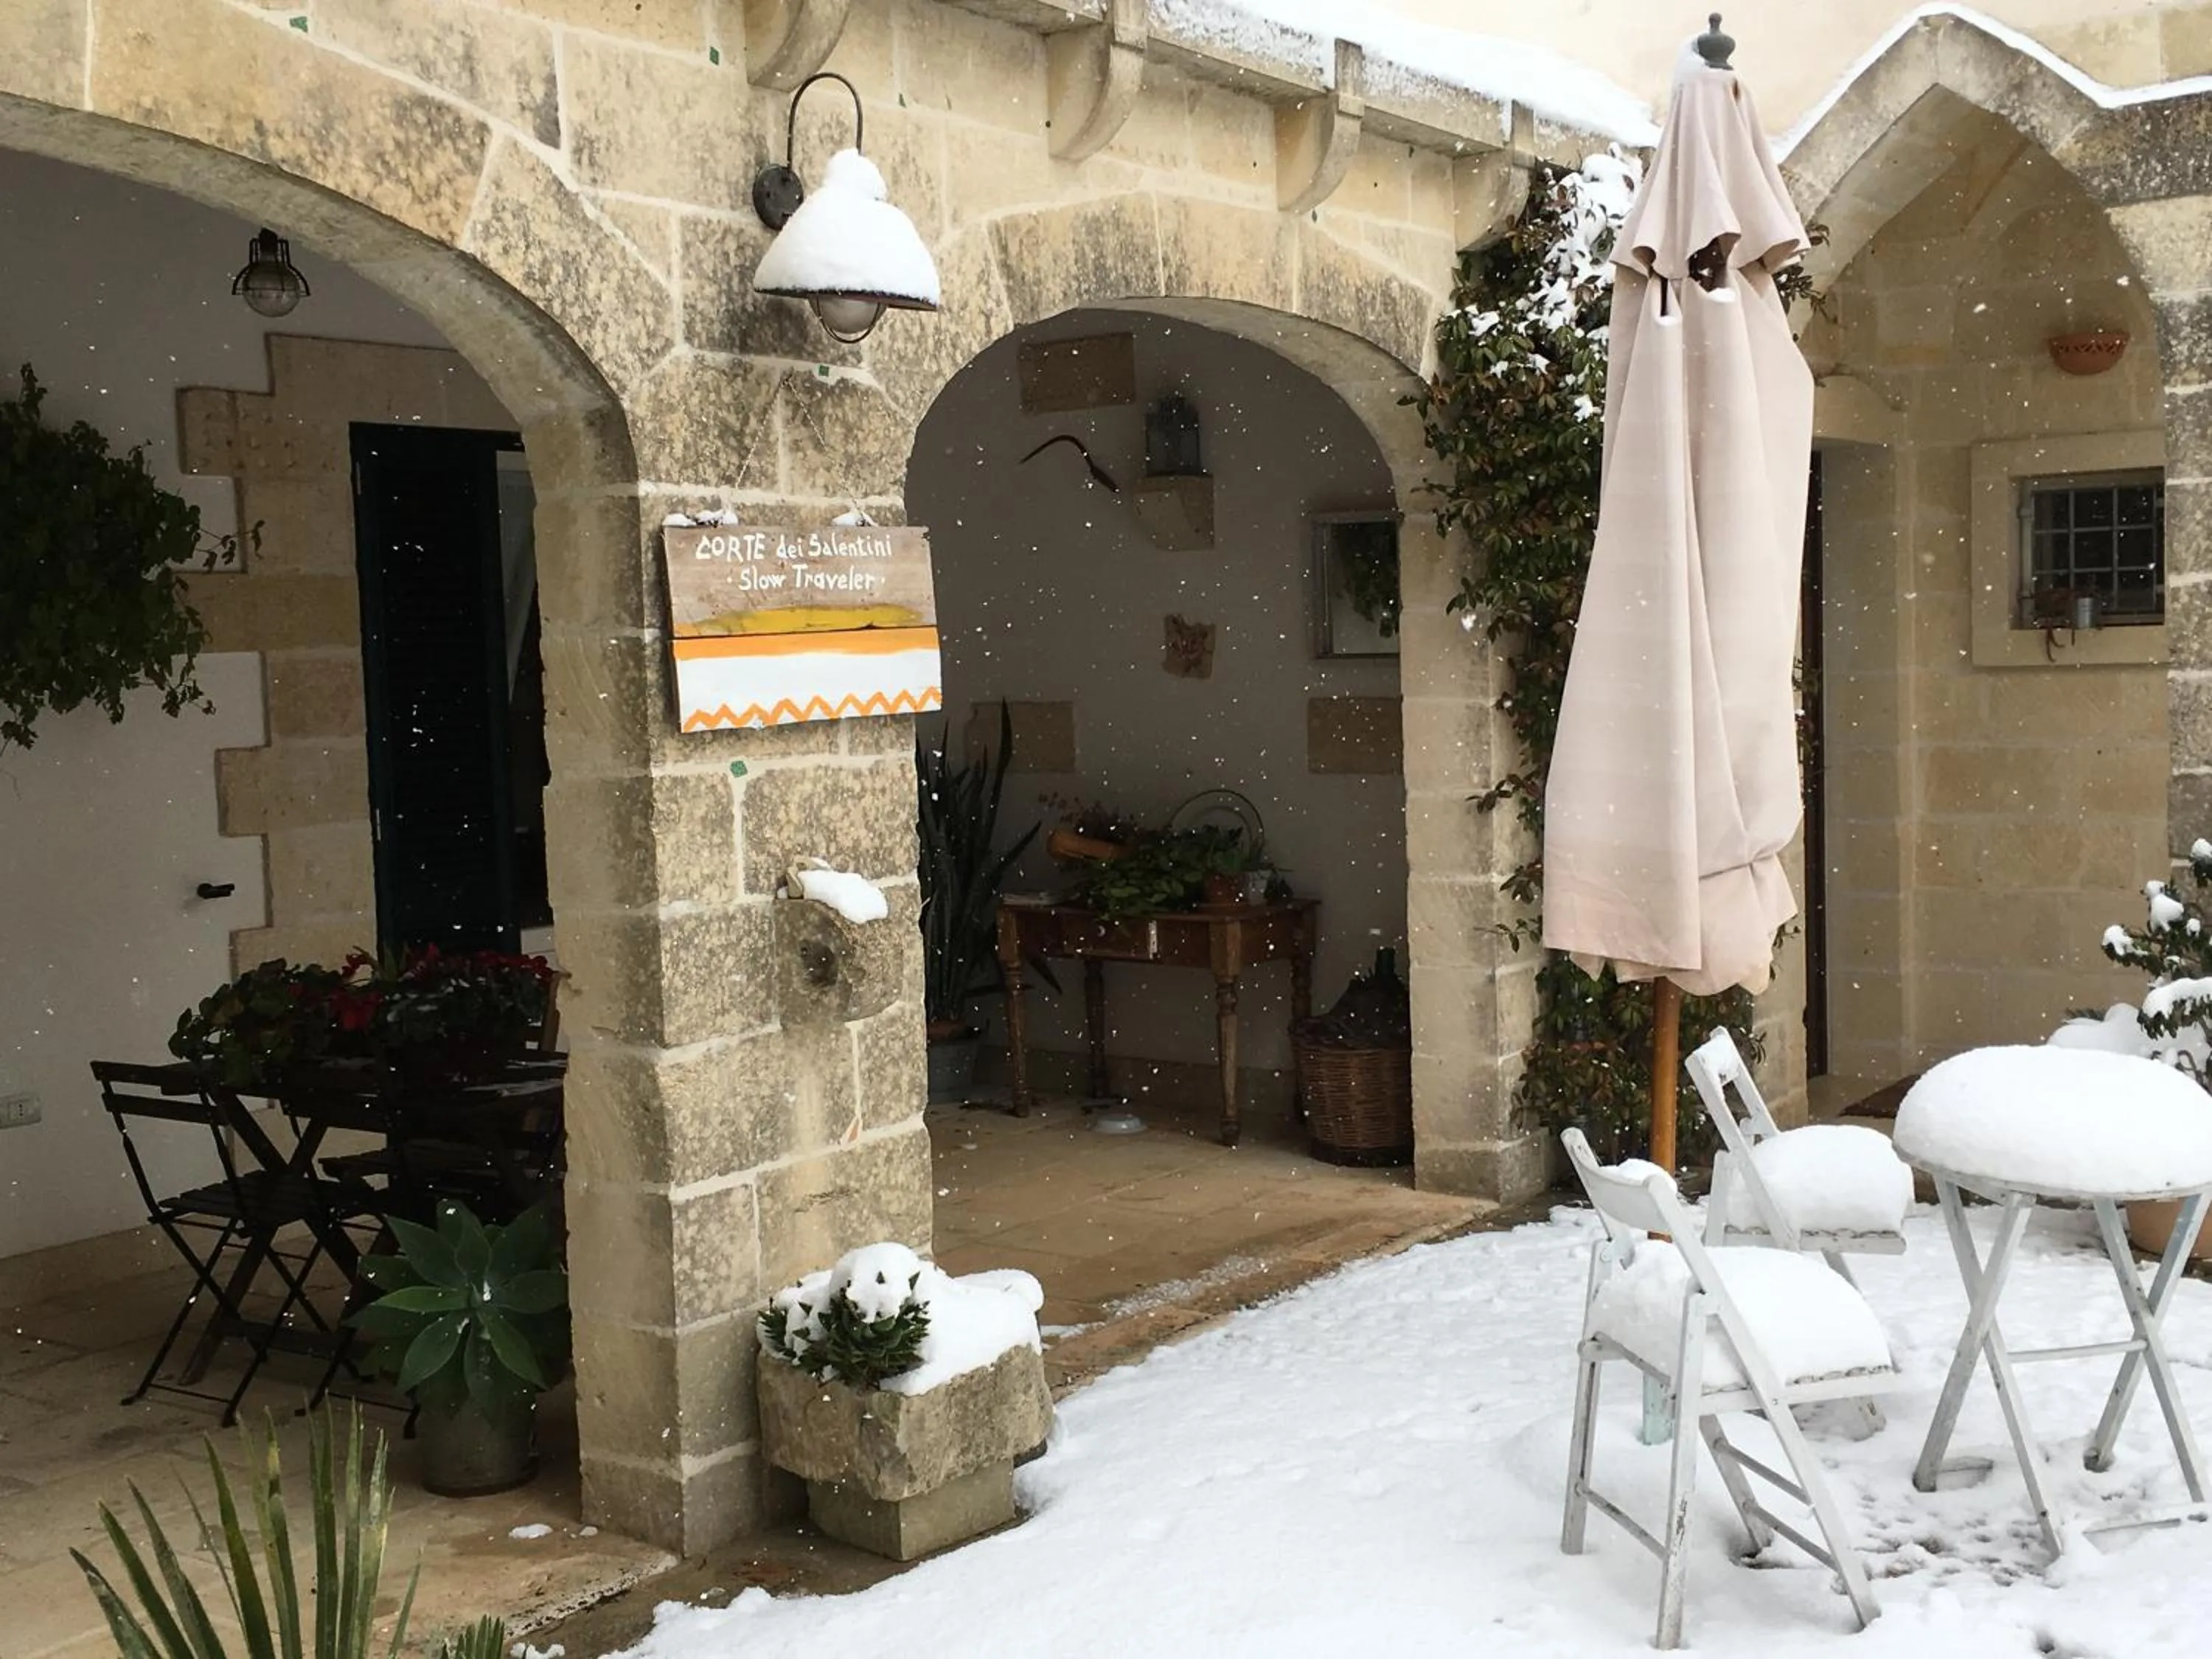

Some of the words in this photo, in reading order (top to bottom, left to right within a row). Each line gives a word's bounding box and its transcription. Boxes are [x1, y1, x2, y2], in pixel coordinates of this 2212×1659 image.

[695, 533, 766, 562] CORTE
[776, 535, 802, 559] dei
[808, 532, 892, 557] Salentini
[738, 566, 786, 591] Slow
[792, 563, 875, 590] Traveler
